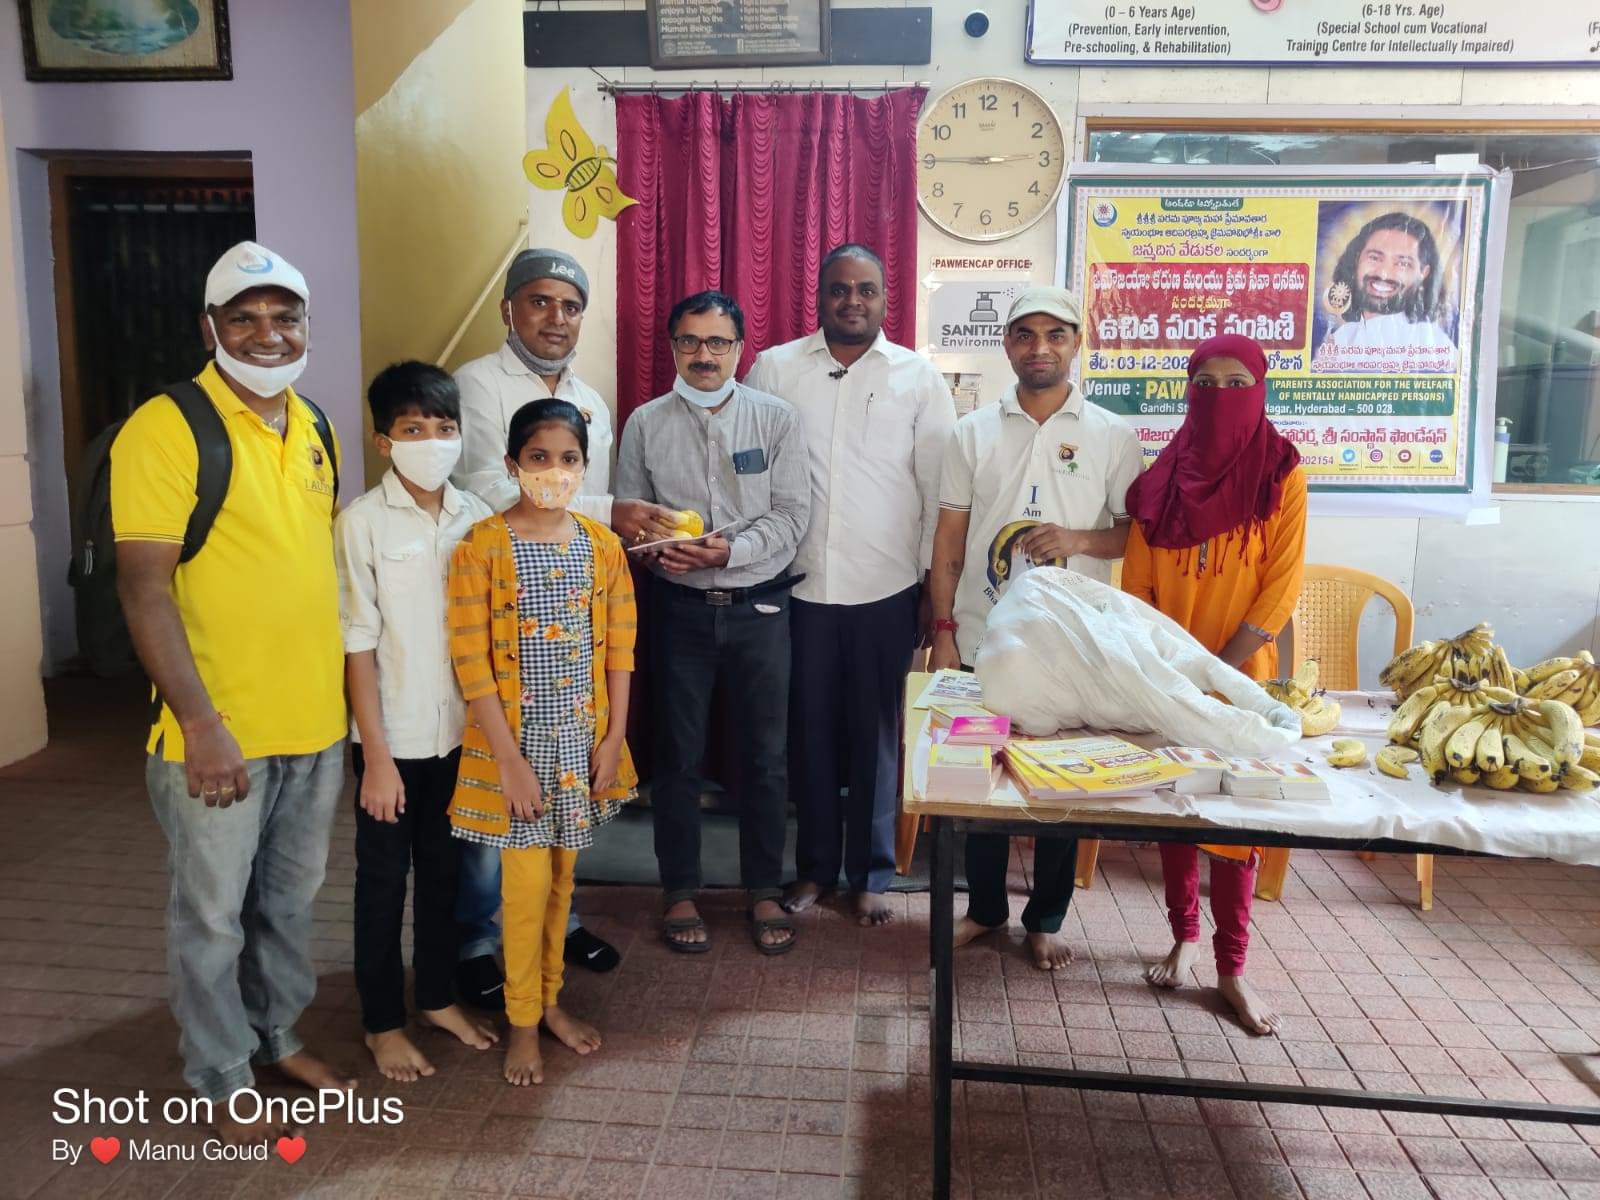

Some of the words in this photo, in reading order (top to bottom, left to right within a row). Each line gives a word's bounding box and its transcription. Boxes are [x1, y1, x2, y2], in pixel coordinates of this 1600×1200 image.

[686, 6, 697, 14] the
[1128, 6, 1135, 18] 6
[1139, 6, 1167, 18] Years
[1171, 6, 1195, 20] Age)
[1362, 4, 1391, 18] (6-18
[1395, 4, 1415, 16] Yrs.
[1419, 4, 1444, 18] Age)
[712, 15, 723, 23] the
[1068, 23, 1131, 37] (Prevention,
[1134, 23, 1161, 37] Early
[1164, 23, 1230, 37] intervention,
[1317, 21, 1360, 36] (Special
[1364, 22, 1400, 34] School
[1404, 24, 1427, 34] cum
[1431, 22, 1487, 34] Vocational
[1064, 41, 1139, 55] Pre-schooling,
[1143, 42, 1150, 53] &
[1154, 41, 1231, 55] Rehabilitation)
[1287, 40, 1329, 54] Training
[1332, 40, 1367, 52] Centre
[1370, 40, 1385, 52] for
[1389, 40, 1458, 54] Intellectually
[1461, 40, 1514, 54] Impaired)
[952, 102, 966, 119] 11
[978, 95, 997, 111] 12
[1012, 101, 1019, 118] 1
[931, 125, 951, 140] 10
[1031, 123, 1043, 138] 2
[924, 153, 936, 169] 9
[1039, 151, 1050, 167] 3
[932, 182, 944, 197] 8
[1028, 181, 1040, 196] 4
[953, 203, 964, 218] 7
[980, 209, 991, 225] 6
[1008, 202, 1019, 217] 5
[1179, 240, 1223, 257] వేడుకల
[550, 262, 575, 278] Lee
[934, 259, 994, 269] PAWMENCAP
[997, 259, 1030, 269] OFFICE
[1100, 312, 1159, 341] ఉచిత
[941, 337, 1005, 347] Environm
[1117, 355, 1189, 370] 03-12-202
[1085, 380, 1131, 396] Venue
[1145, 380, 1187, 400] PAW
[1272, 380, 1313, 391] (PARENTS
[1315, 380, 1371, 390] ASSOCIATION
[1374, 380, 1391, 390] FOR
[1394, 380, 1410, 390] THE
[1413, 380, 1453, 390] WELFARE
[1279, 392, 1290, 401] OF
[1293, 392, 1335, 401] MENTALLY
[1338, 392, 1399, 402] HANDICAPPED
[1402, 392, 1445, 402] PERSONS)
[1140, 403, 1175, 413] Gandhi
[1294, 403, 1346, 415] Hyderabad
[1357, 404, 1373, 414] 500
[1376, 404, 1395, 414] 028.
[1299, 456, 1334, 465] 902154
[1029, 485, 1039, 504] I
[1022, 507, 1042, 517] Am
